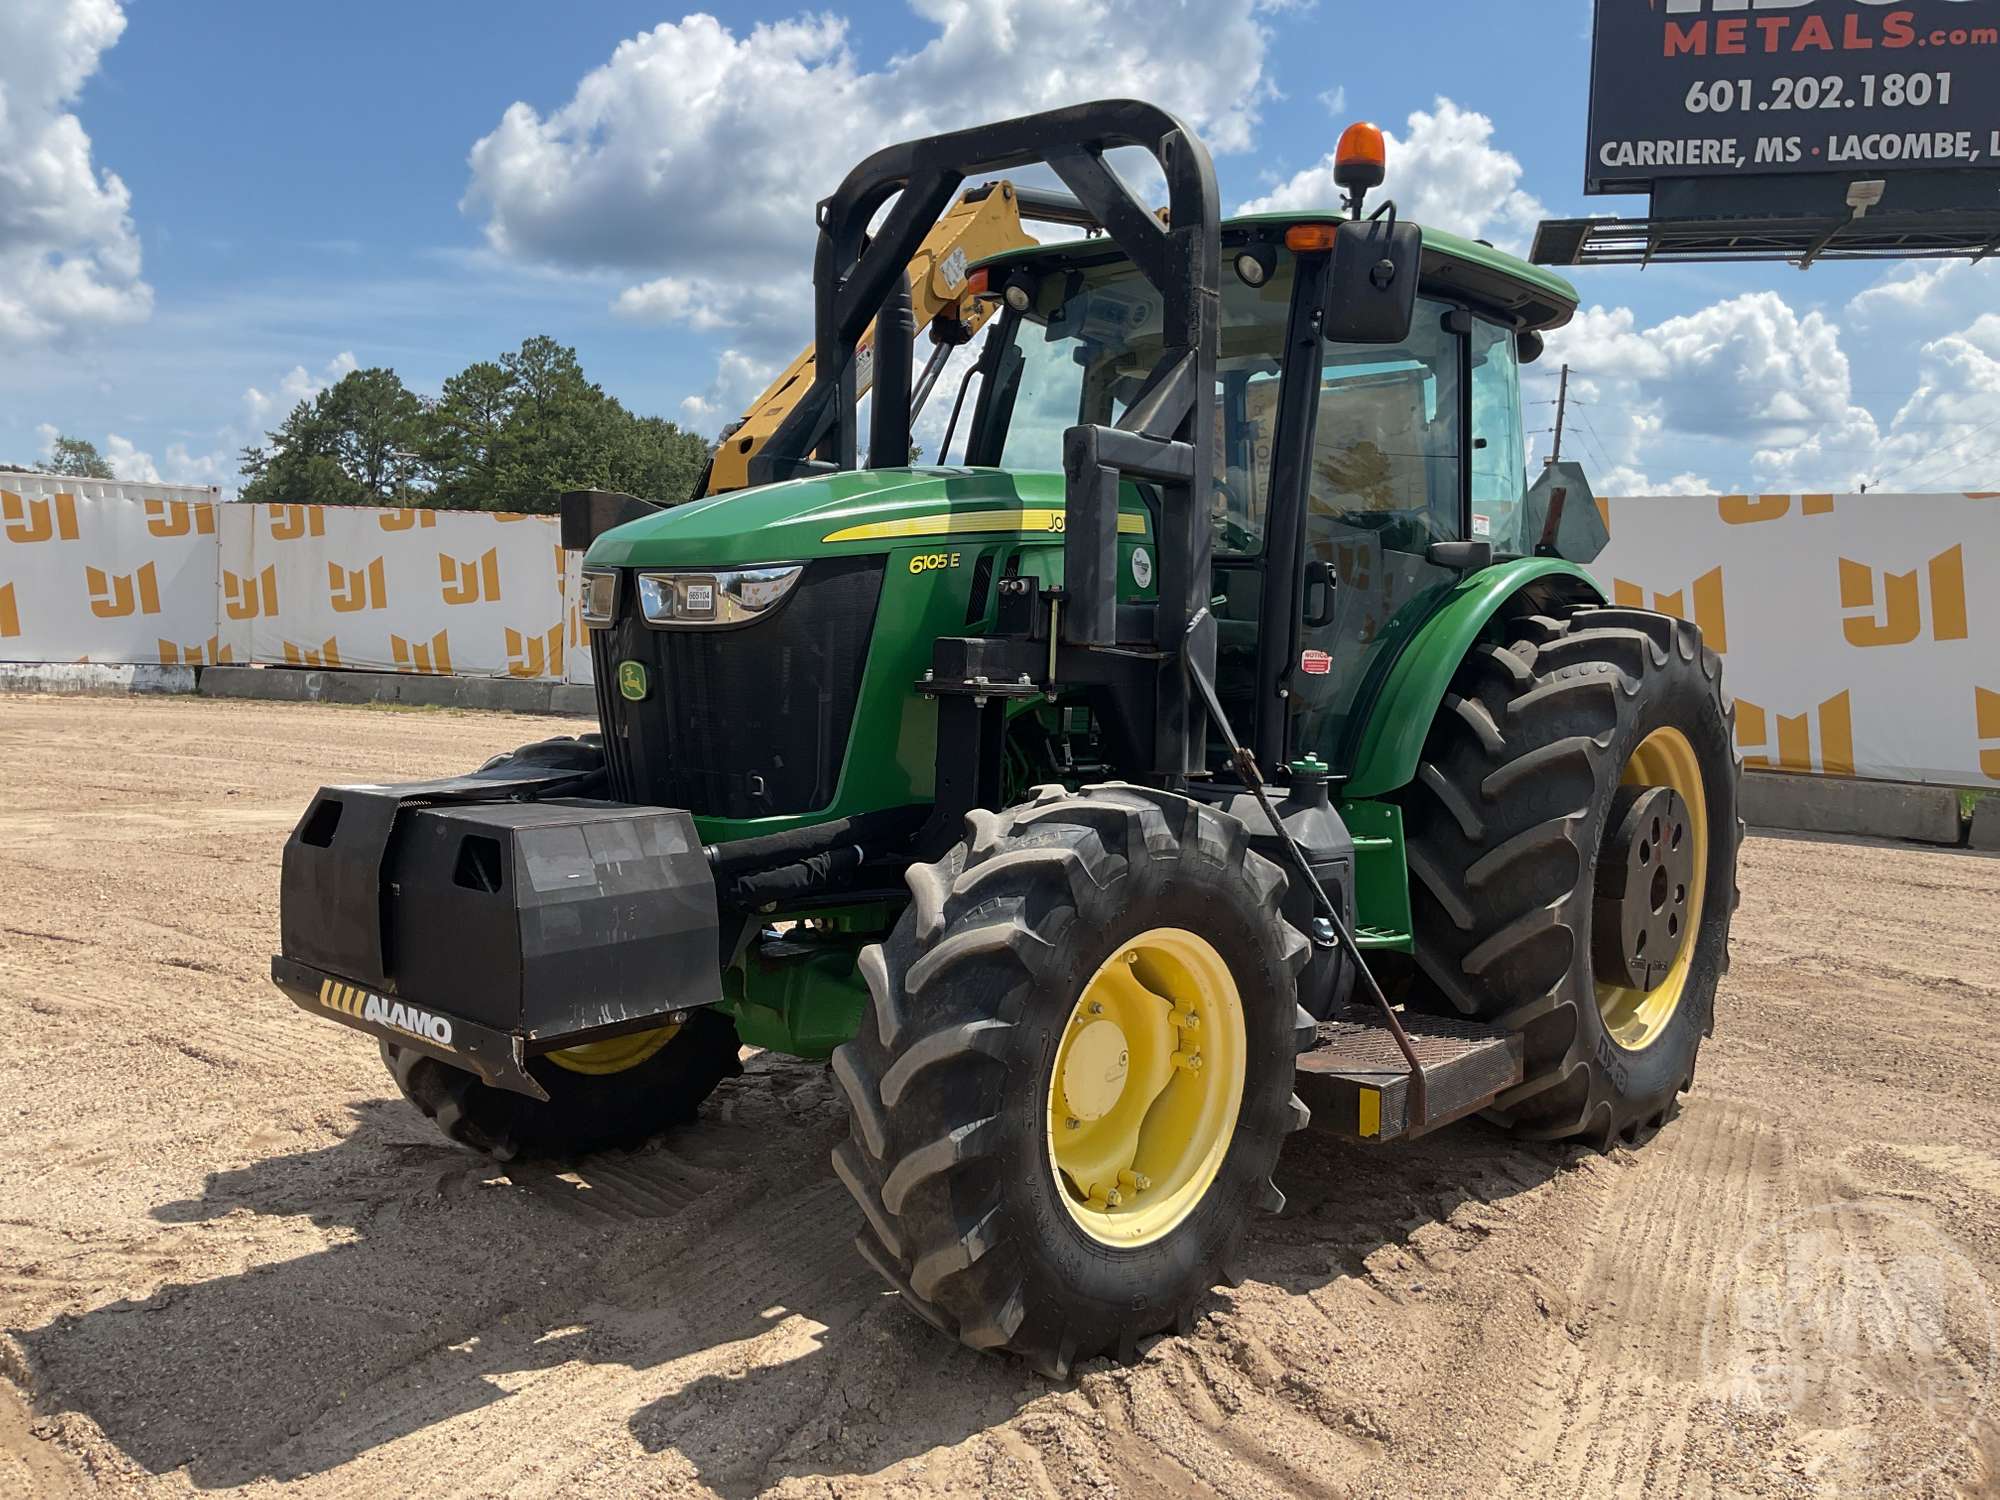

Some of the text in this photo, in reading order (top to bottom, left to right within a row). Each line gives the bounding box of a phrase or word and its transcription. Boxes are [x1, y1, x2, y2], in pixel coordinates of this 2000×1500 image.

[1663, 11, 1998, 57] METALS.com
[1685, 72, 1952, 113] 601.202.1801
[1600, 138, 1745, 168] CARRIERE,
[1754, 137, 1801, 163] MS
[1828, 131, 1981, 162] LACOMBE,
[364, 994, 452, 1044] ALAMO
